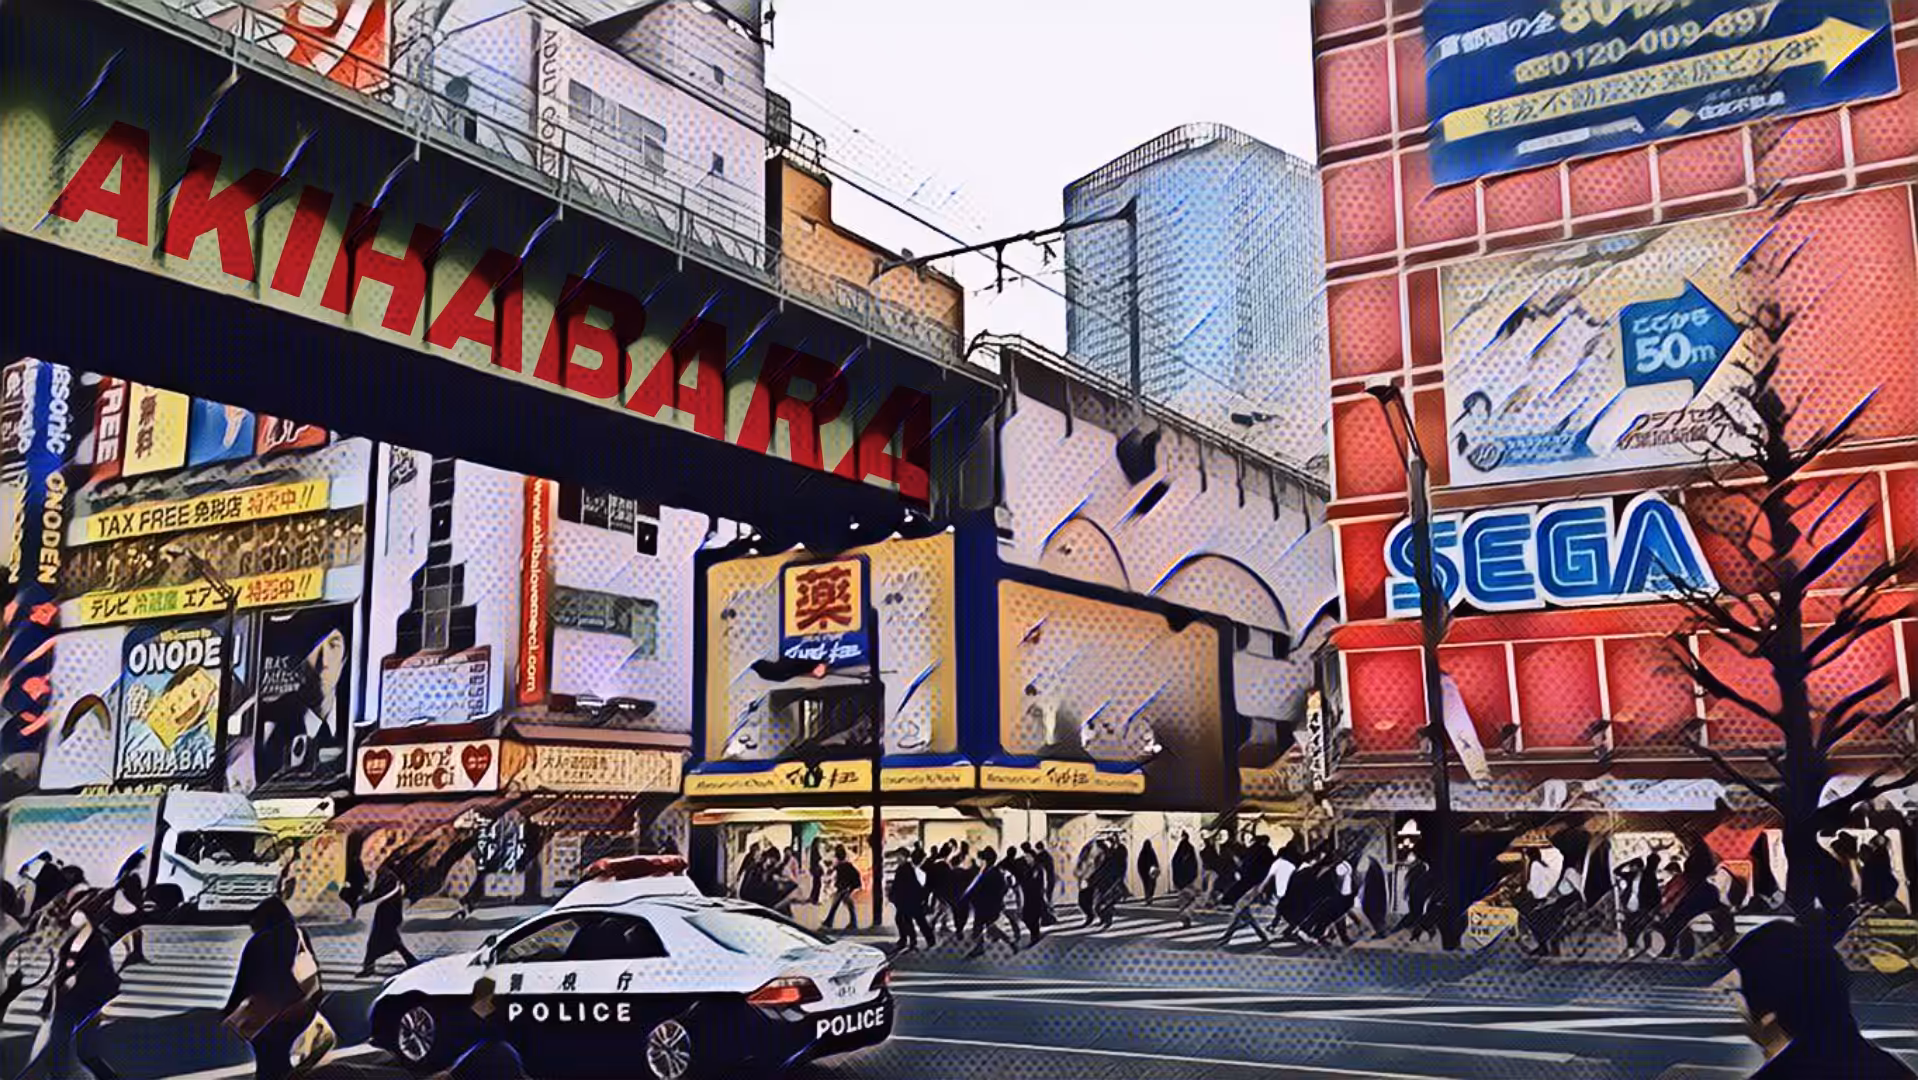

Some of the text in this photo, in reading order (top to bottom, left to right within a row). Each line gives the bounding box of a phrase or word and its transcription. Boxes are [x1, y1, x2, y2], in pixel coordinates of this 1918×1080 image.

[1552, 3, 1777, 75] 0120-009-897
[542, 29, 558, 98] ADULT
[1635, 332, 1717, 374] 50m
[37, 471, 68, 584] ONODEN
[98, 512, 140, 537] TAX
[139, 505, 191, 532] FREE
[1386, 495, 1717, 615] SEGA
[91, 596, 130, 619] テレビ
[795, 566, 852, 631] 薬
[402, 747, 453, 769] LOVE
[396, 768, 455, 790] merci
[508, 1002, 631, 1022] POLICE
[816, 1007, 884, 1039] POLICE
